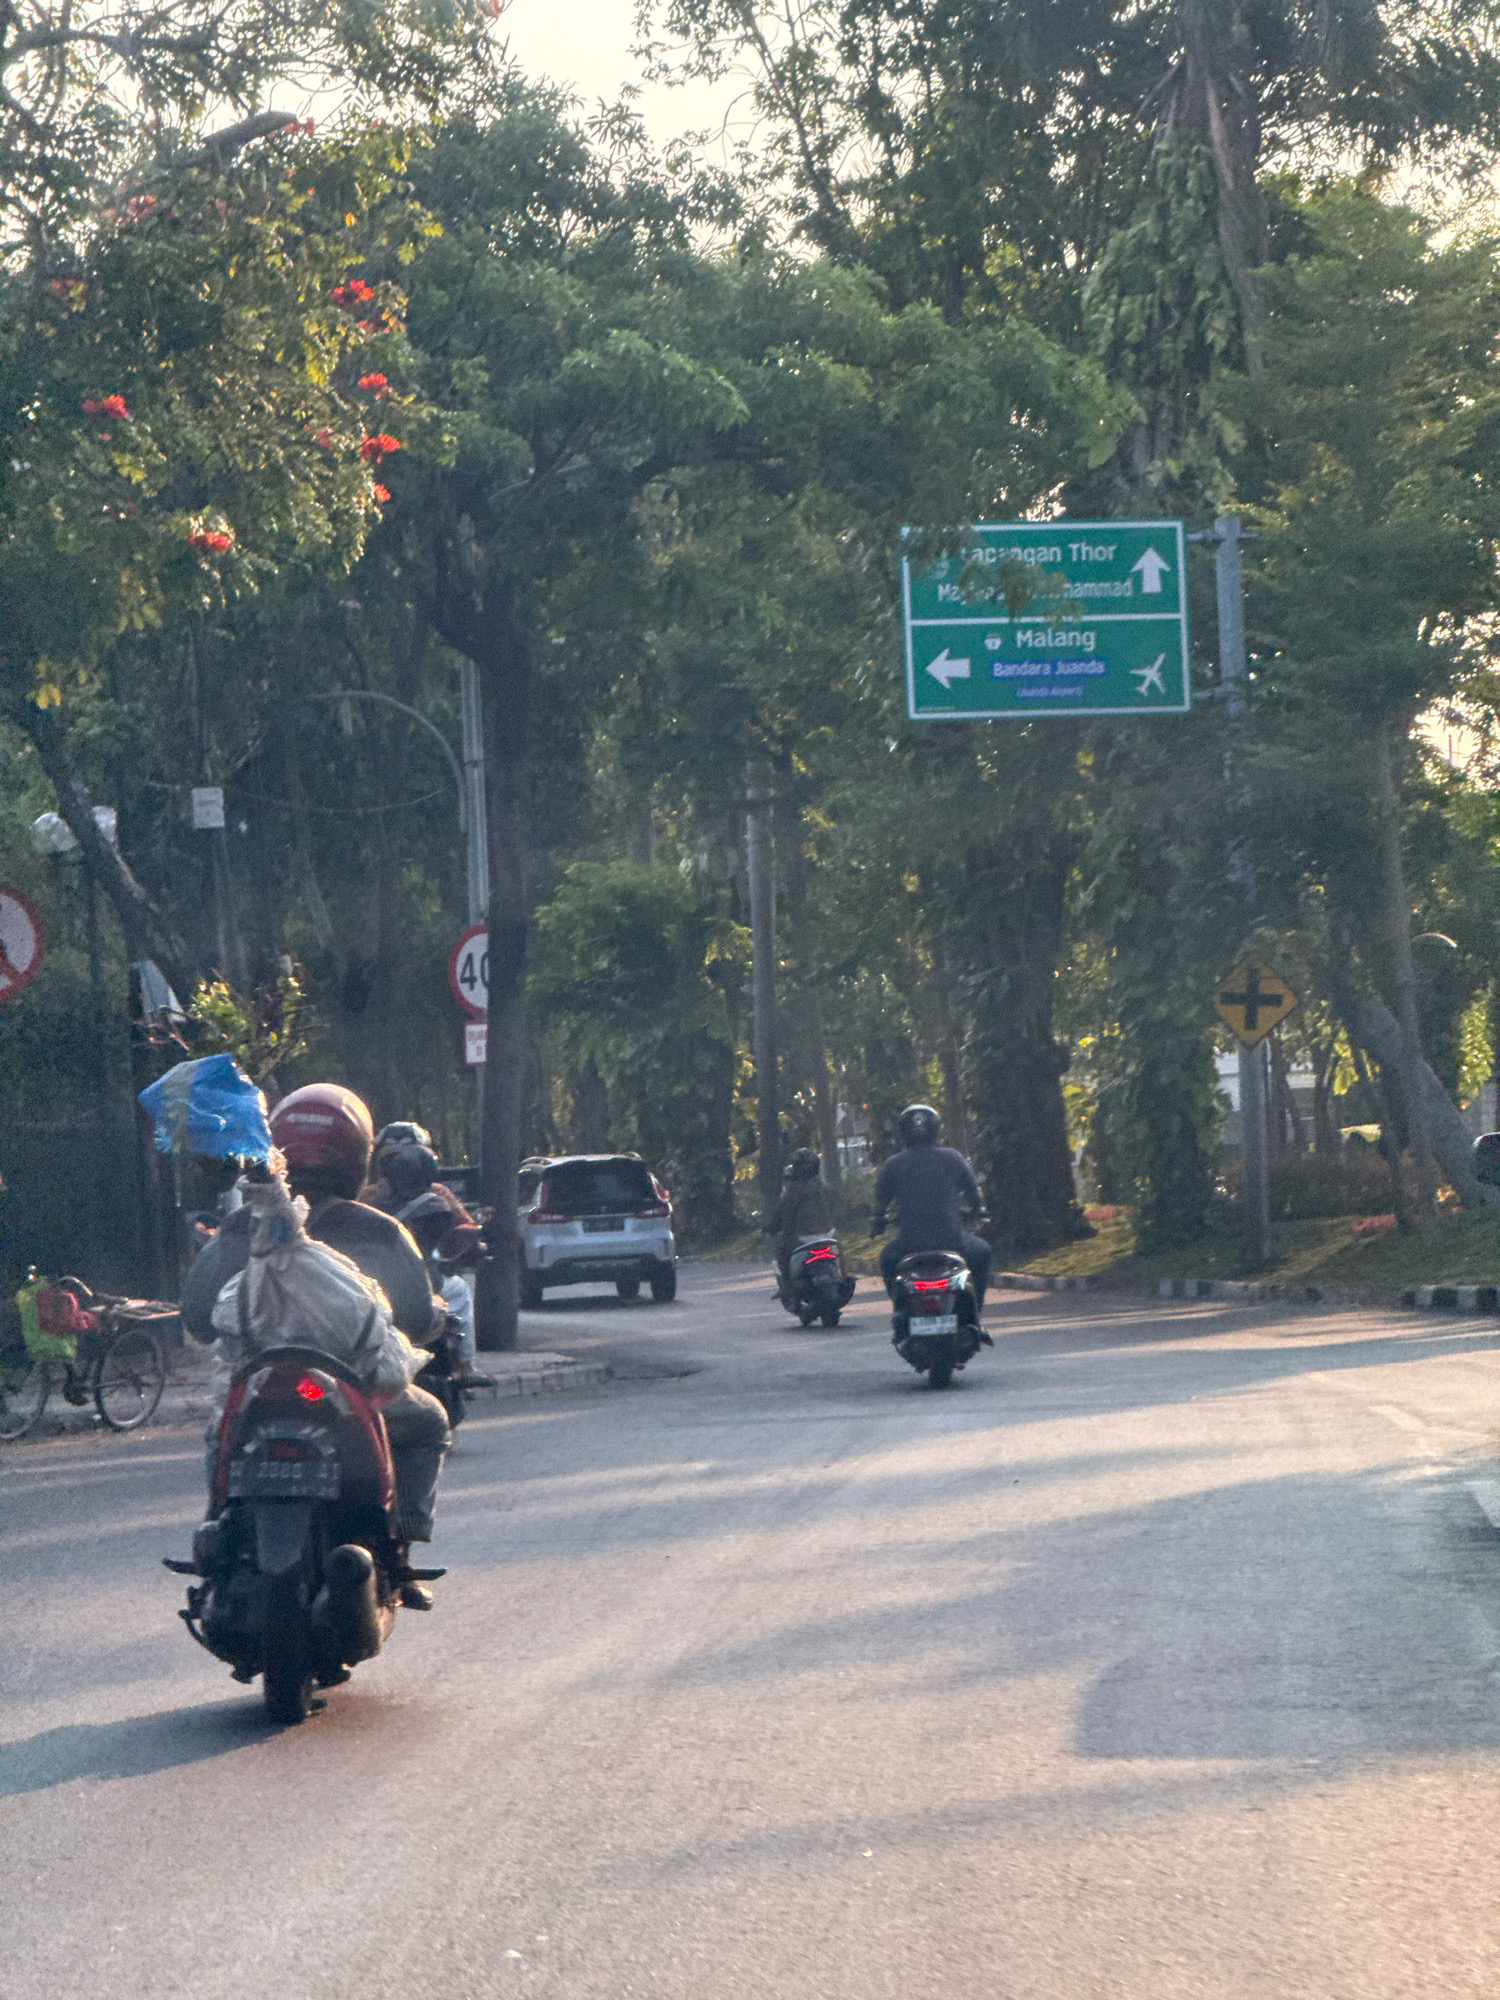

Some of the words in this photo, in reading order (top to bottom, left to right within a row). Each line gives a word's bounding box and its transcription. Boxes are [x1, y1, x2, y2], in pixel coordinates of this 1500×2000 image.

[1068, 542, 1117, 562] Thor
[1016, 628, 1096, 652] Malang
[993, 661, 1051, 677] Bandara
[1055, 659, 1106, 675] Juanda
